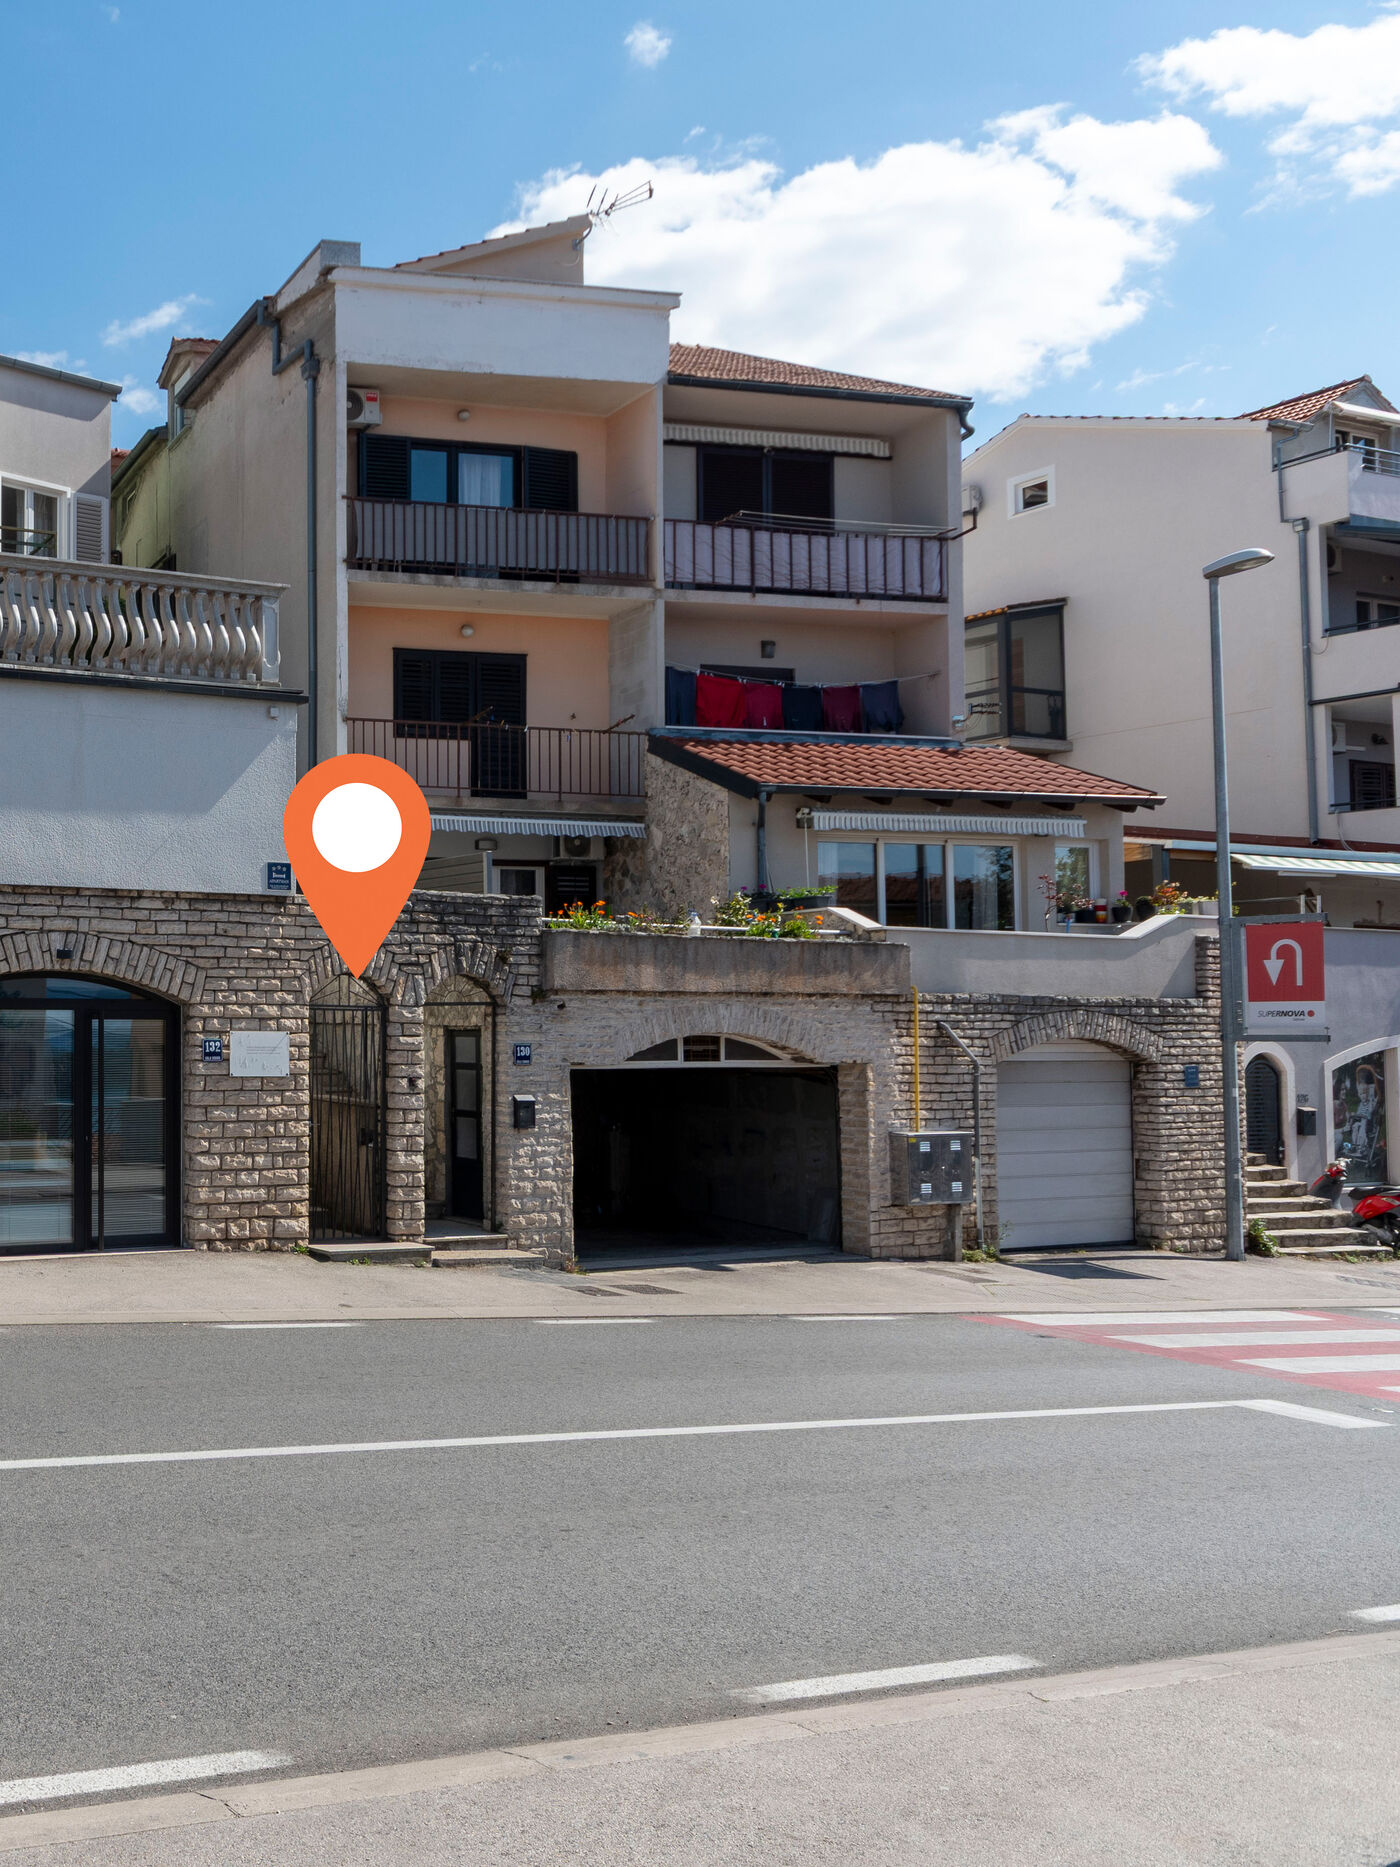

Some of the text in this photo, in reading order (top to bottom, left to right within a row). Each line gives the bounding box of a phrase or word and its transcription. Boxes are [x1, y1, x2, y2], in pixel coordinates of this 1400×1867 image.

[1257, 1009, 1305, 1018] SUPERNOVA
[205, 1041, 221, 1052] 132
[517, 1046, 530, 1056] 130
